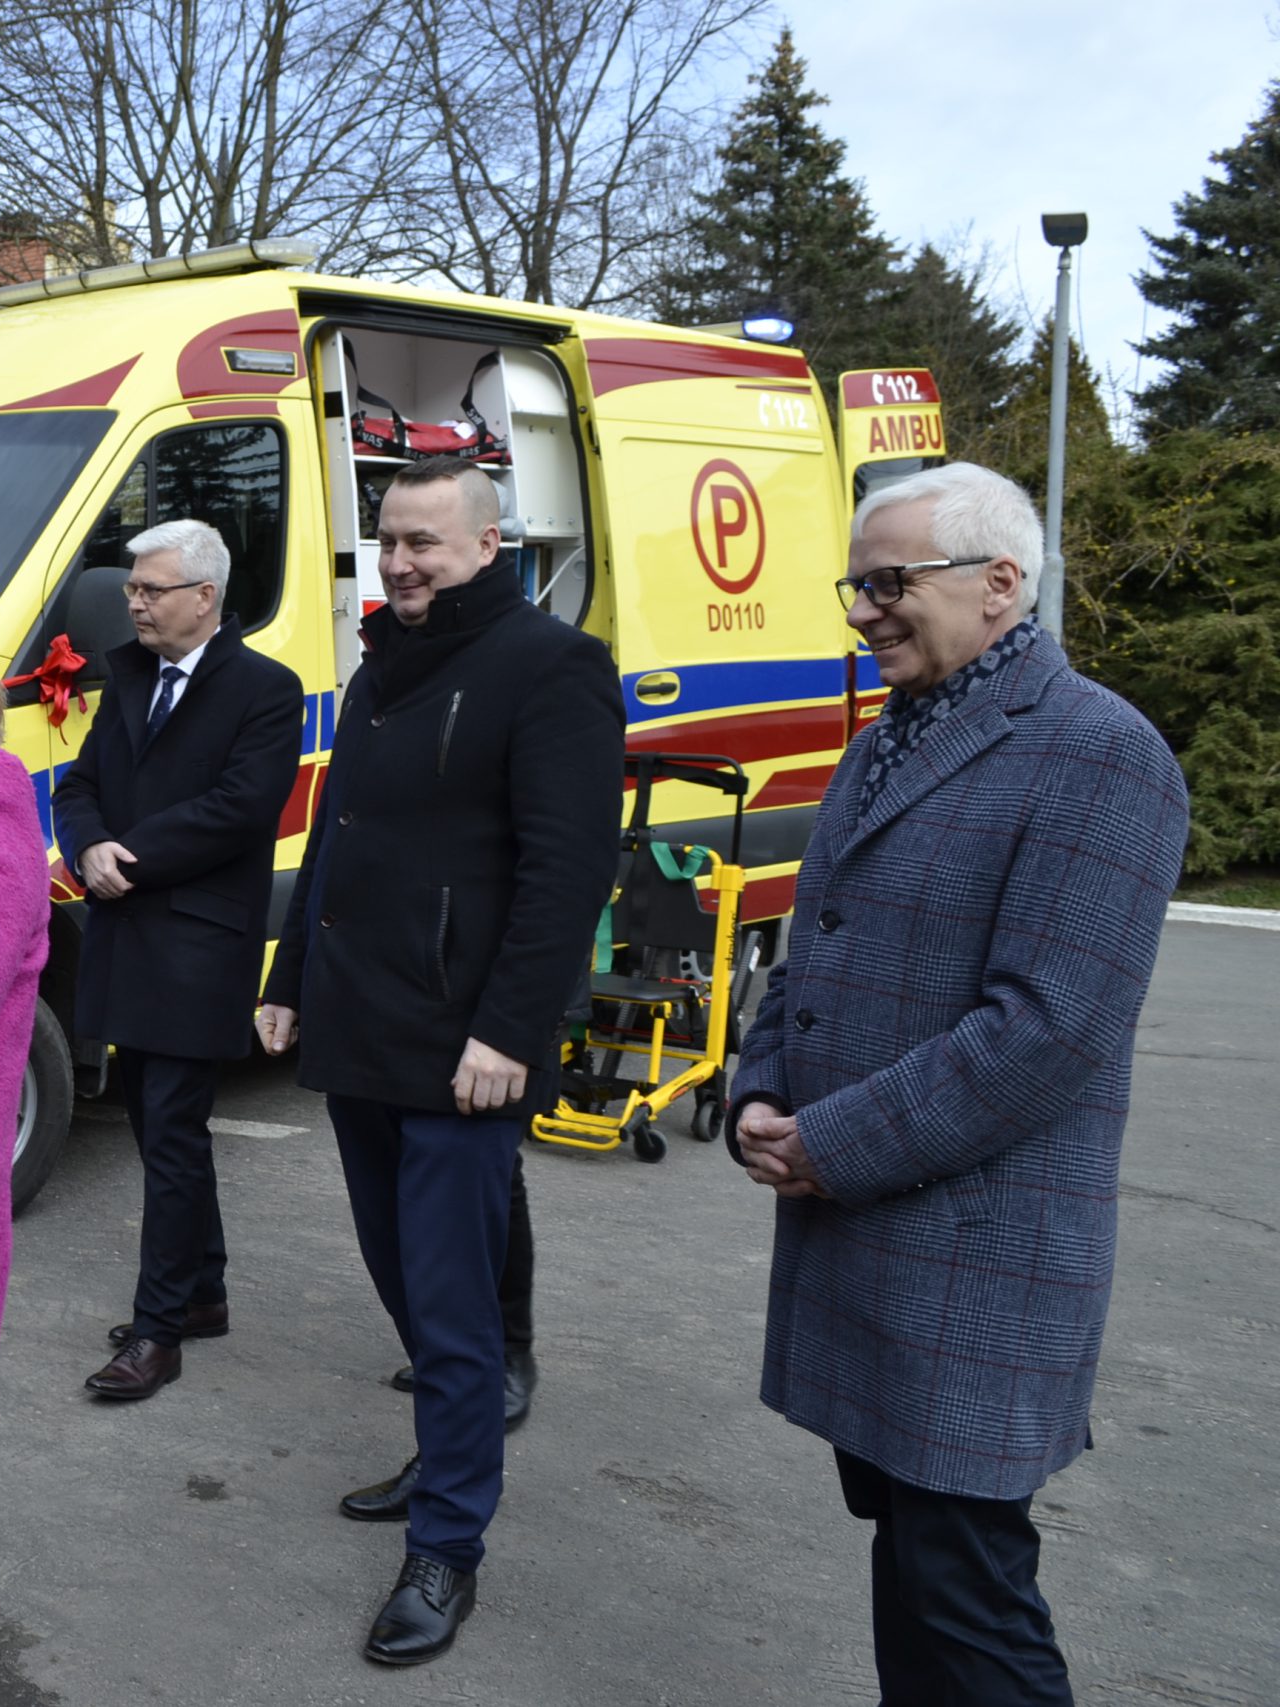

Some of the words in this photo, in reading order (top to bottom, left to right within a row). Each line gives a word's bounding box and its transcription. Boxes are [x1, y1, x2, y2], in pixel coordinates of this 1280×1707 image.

[886, 374, 921, 401] 112
[773, 400, 808, 429] 112
[869, 414, 942, 453] AMBU
[710, 484, 748, 568] P
